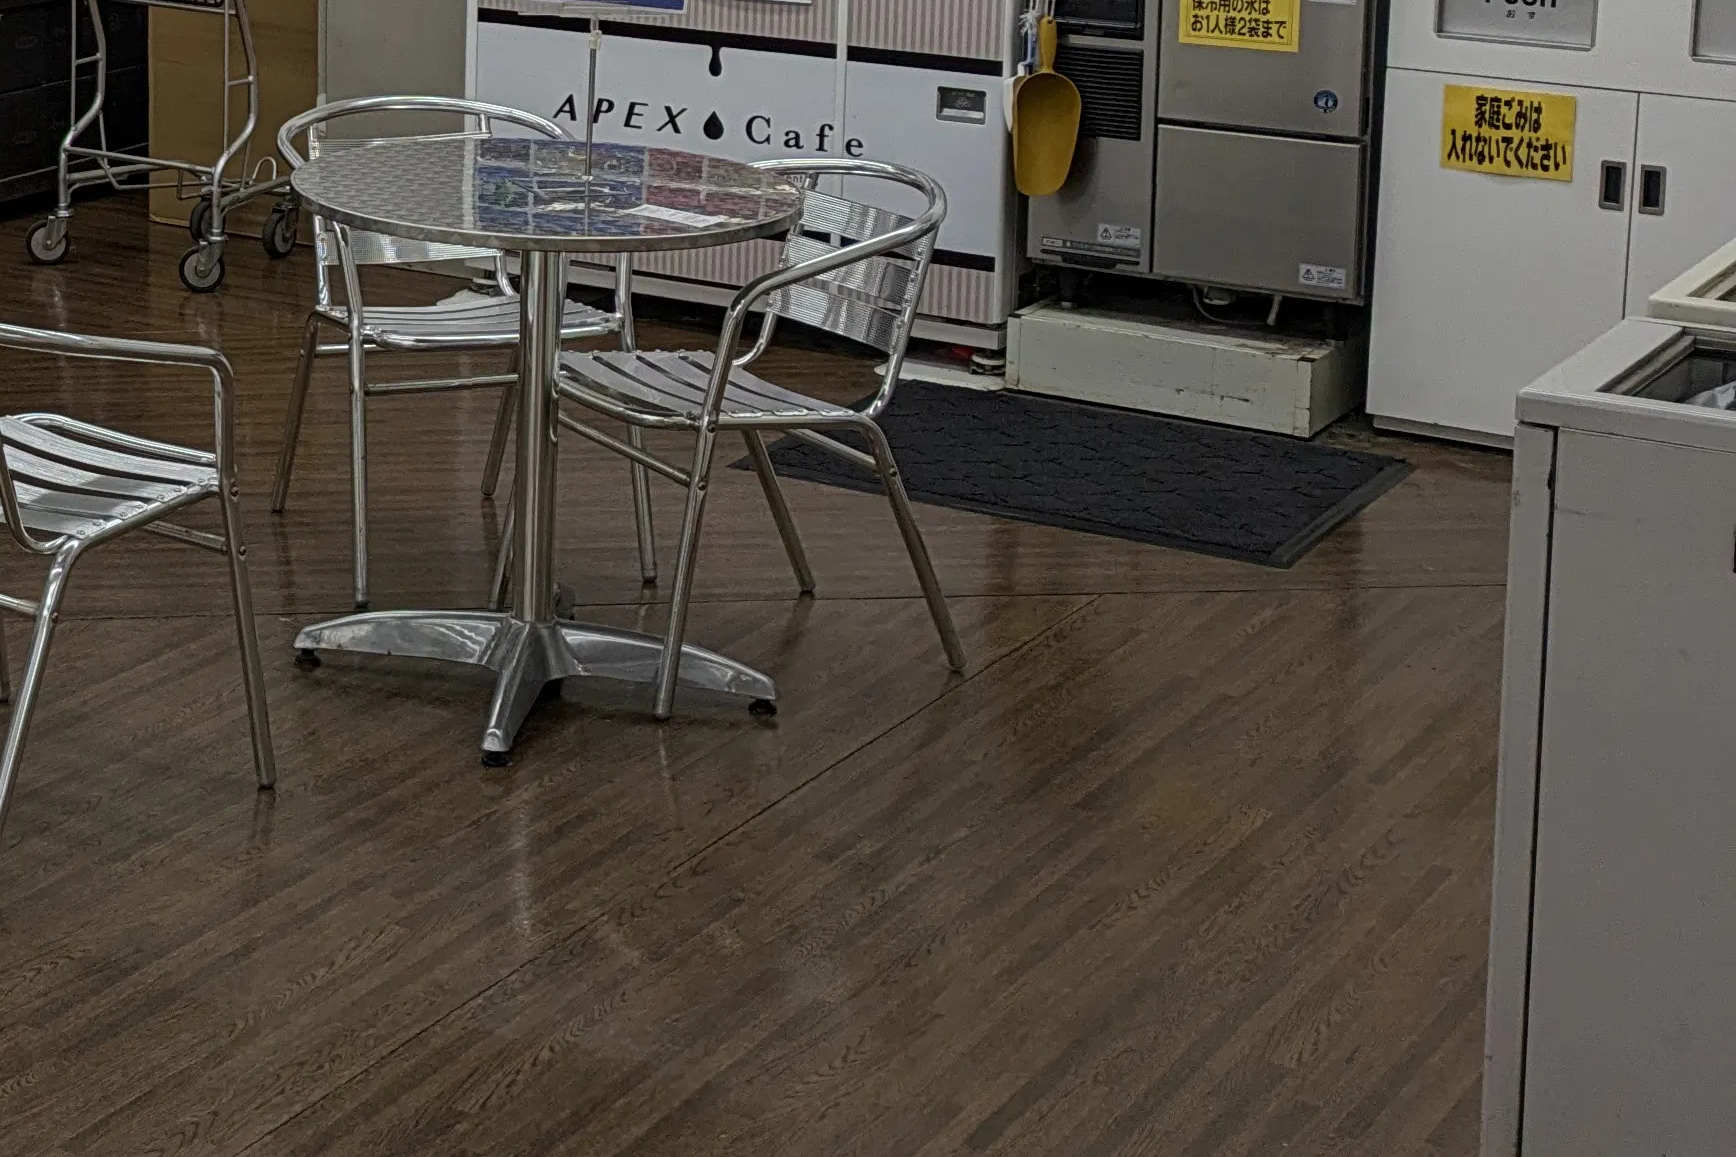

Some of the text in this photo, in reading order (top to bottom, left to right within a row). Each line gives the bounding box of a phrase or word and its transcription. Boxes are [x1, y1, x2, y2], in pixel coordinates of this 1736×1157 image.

[1190, 12, 1289, 41] お1人様2袋まで
[1505, 8, 1537, 20] おす
[551, 92, 865, 159] APEX Cafe
[1473, 93, 1543, 133] 家庭ごみは
[1446, 128, 1567, 172] 入れないでください
